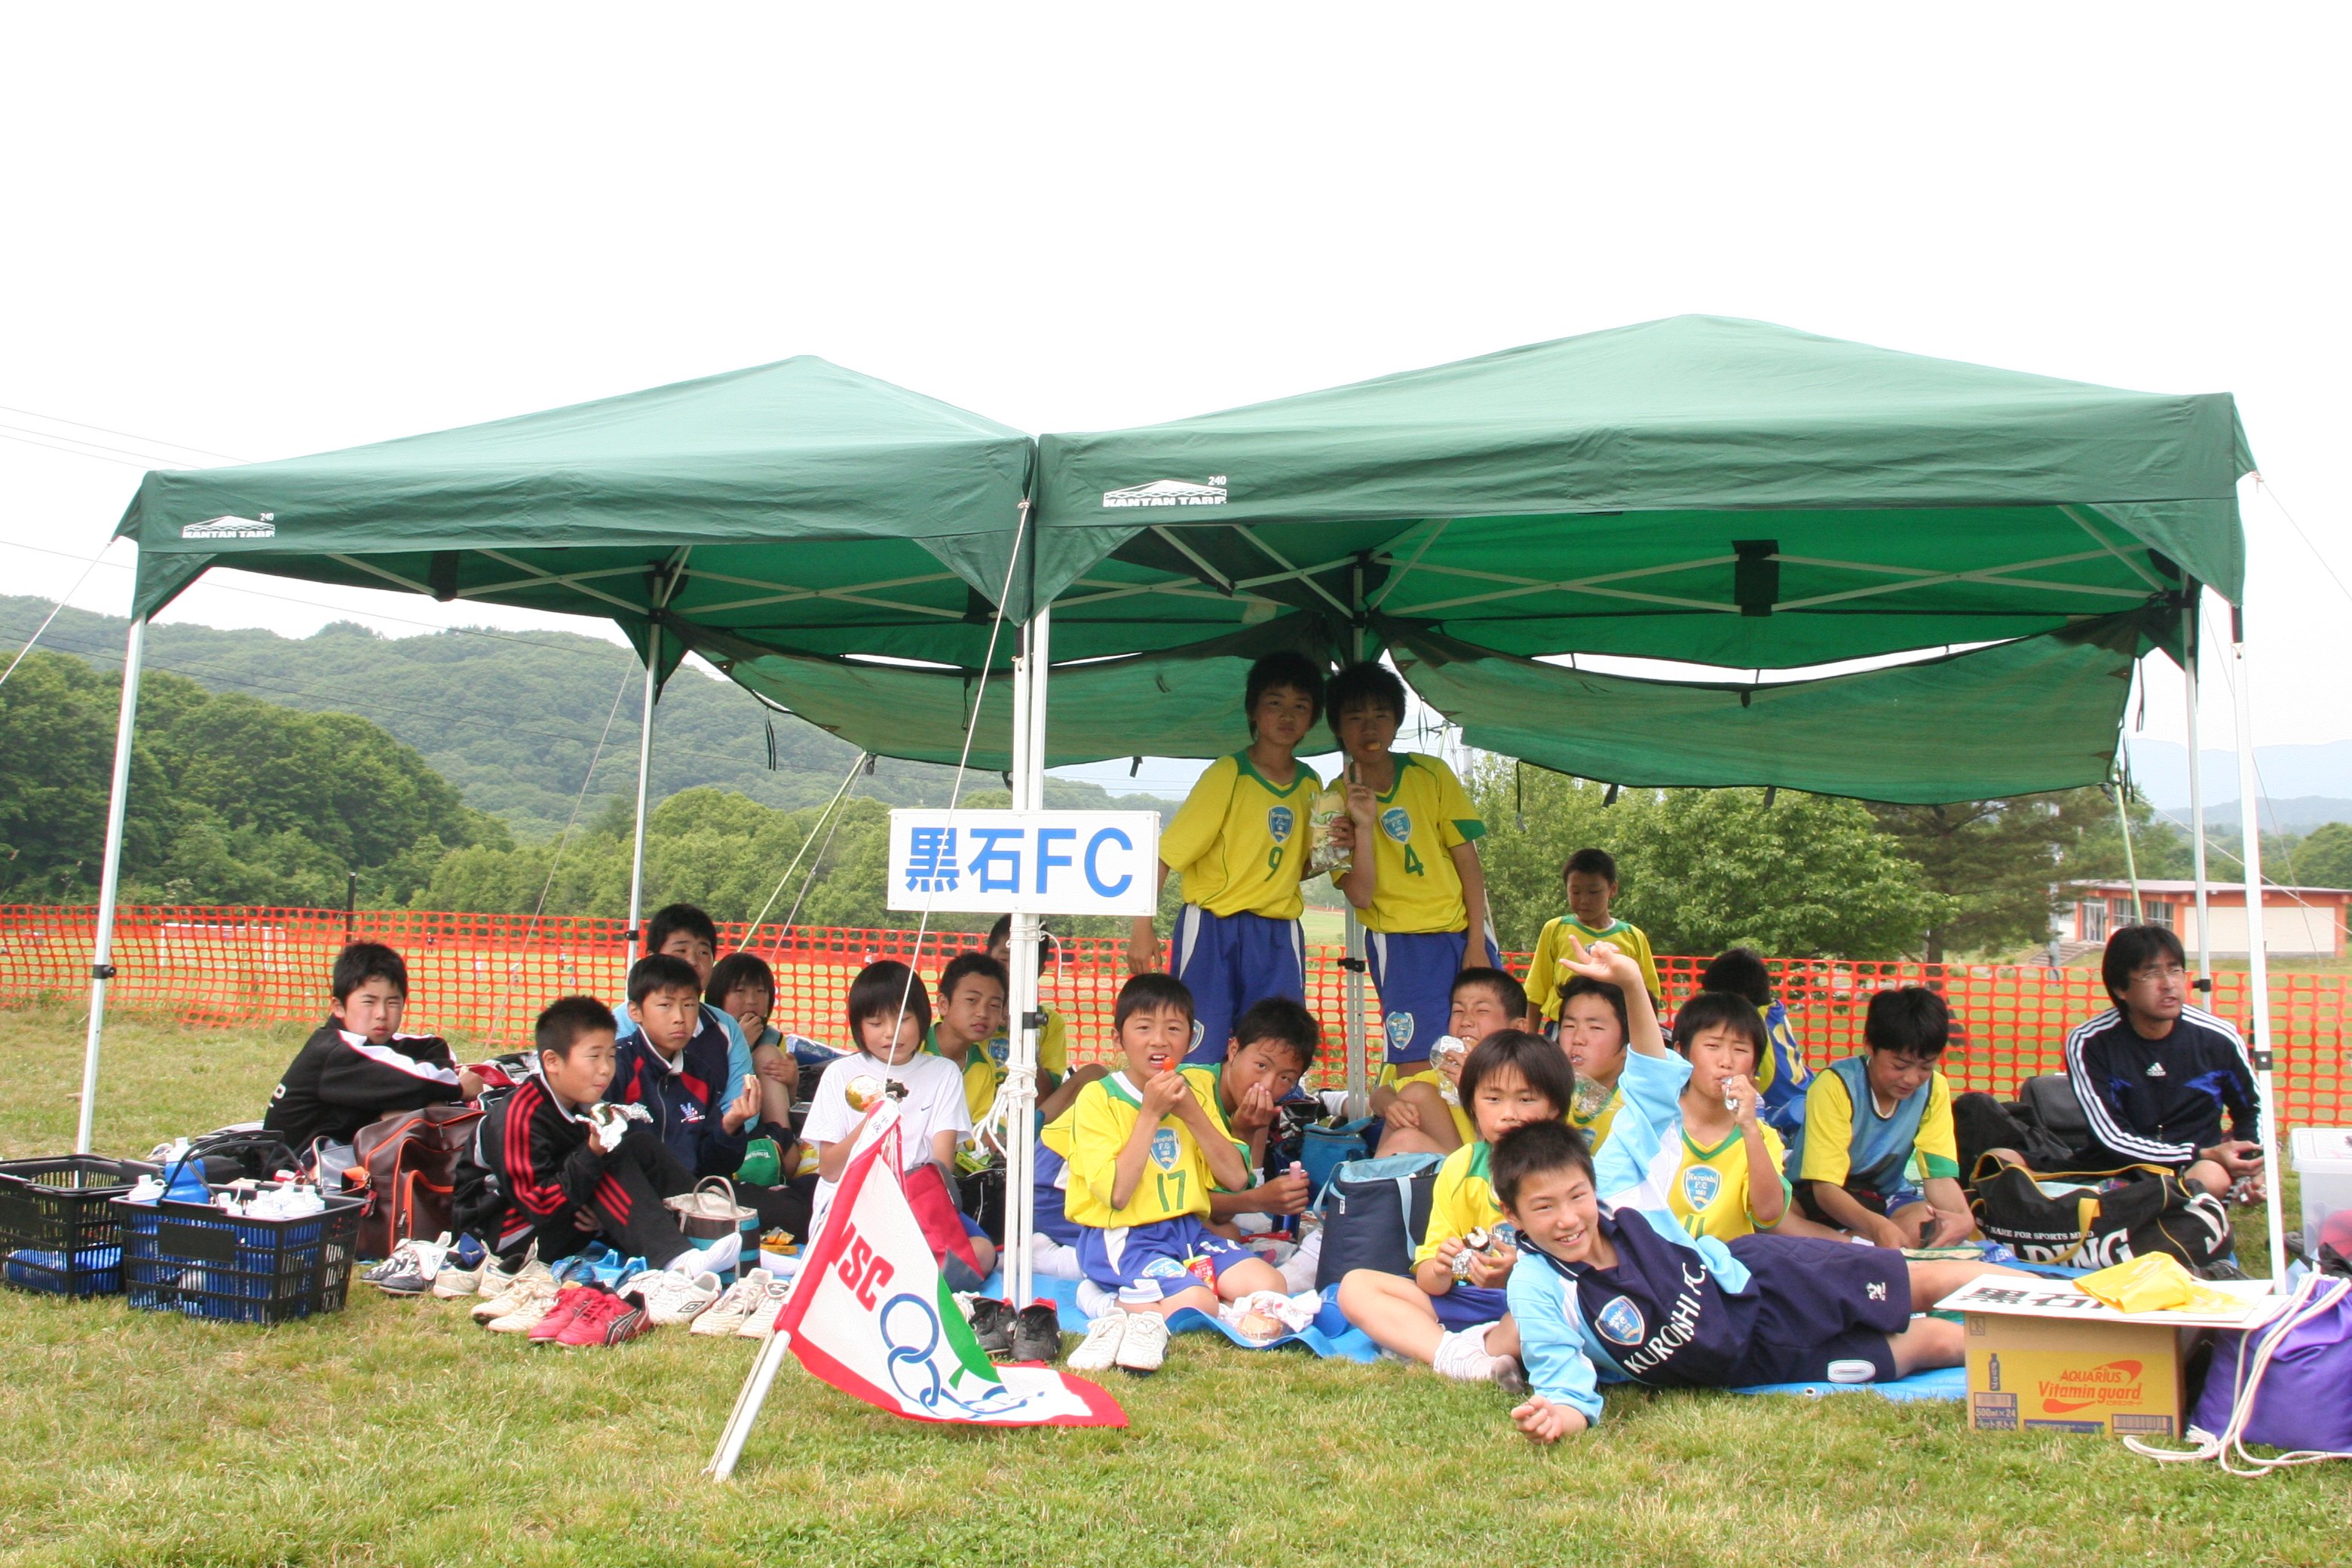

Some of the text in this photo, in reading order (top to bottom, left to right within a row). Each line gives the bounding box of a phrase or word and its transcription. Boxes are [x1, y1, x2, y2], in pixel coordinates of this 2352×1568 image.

[1208, 476, 1227, 485] 240
[1103, 498, 1177, 507] KANTAN
[260, 512, 274, 522] 240
[182, 530, 237, 538] KANTAN
[905, 827, 1134, 898] 黒石FC
[1264, 846, 1283, 882] 9
[1404, 844, 1424, 877] 4
[1157, 1169, 1187, 1212] 17
[2014, 1230, 2032, 1239] FOR
[2033, 1231, 2068, 1241] SPORTS
[2069, 1230, 2094, 1239] MID
[2060, 1367, 2122, 1383] AQUARIUS
[2038, 1380, 2142, 1404] Vitamin guard
